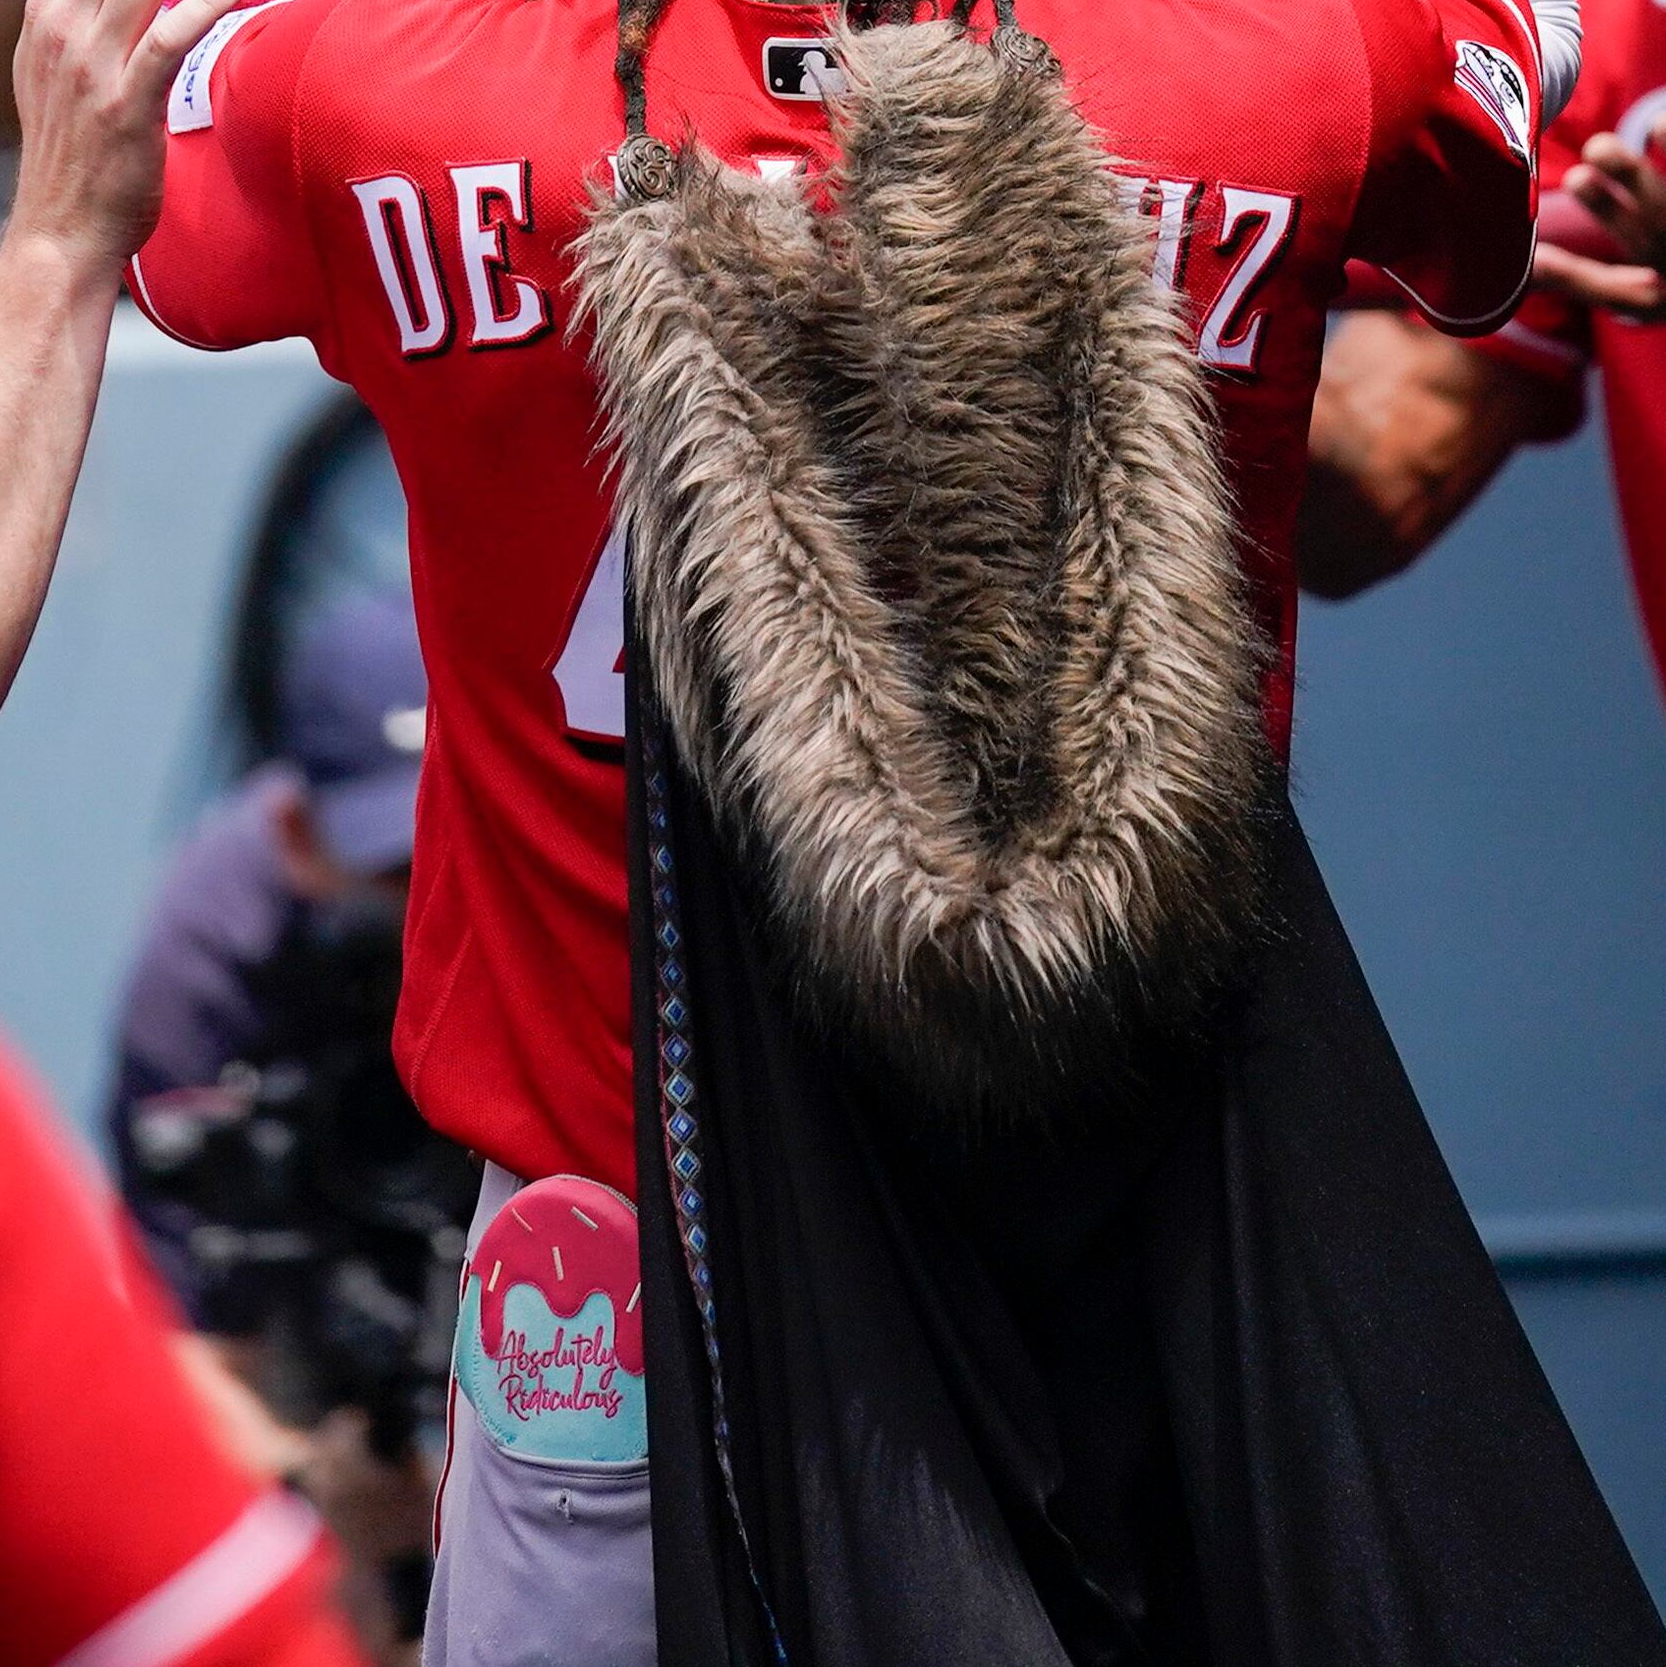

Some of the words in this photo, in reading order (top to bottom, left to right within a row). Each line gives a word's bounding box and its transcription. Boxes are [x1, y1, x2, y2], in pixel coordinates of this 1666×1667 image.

[347, 158, 552, 359] DE
[497, 1324, 618, 1391] Absolutely
[498, 1371, 625, 1423] Ridiculous
